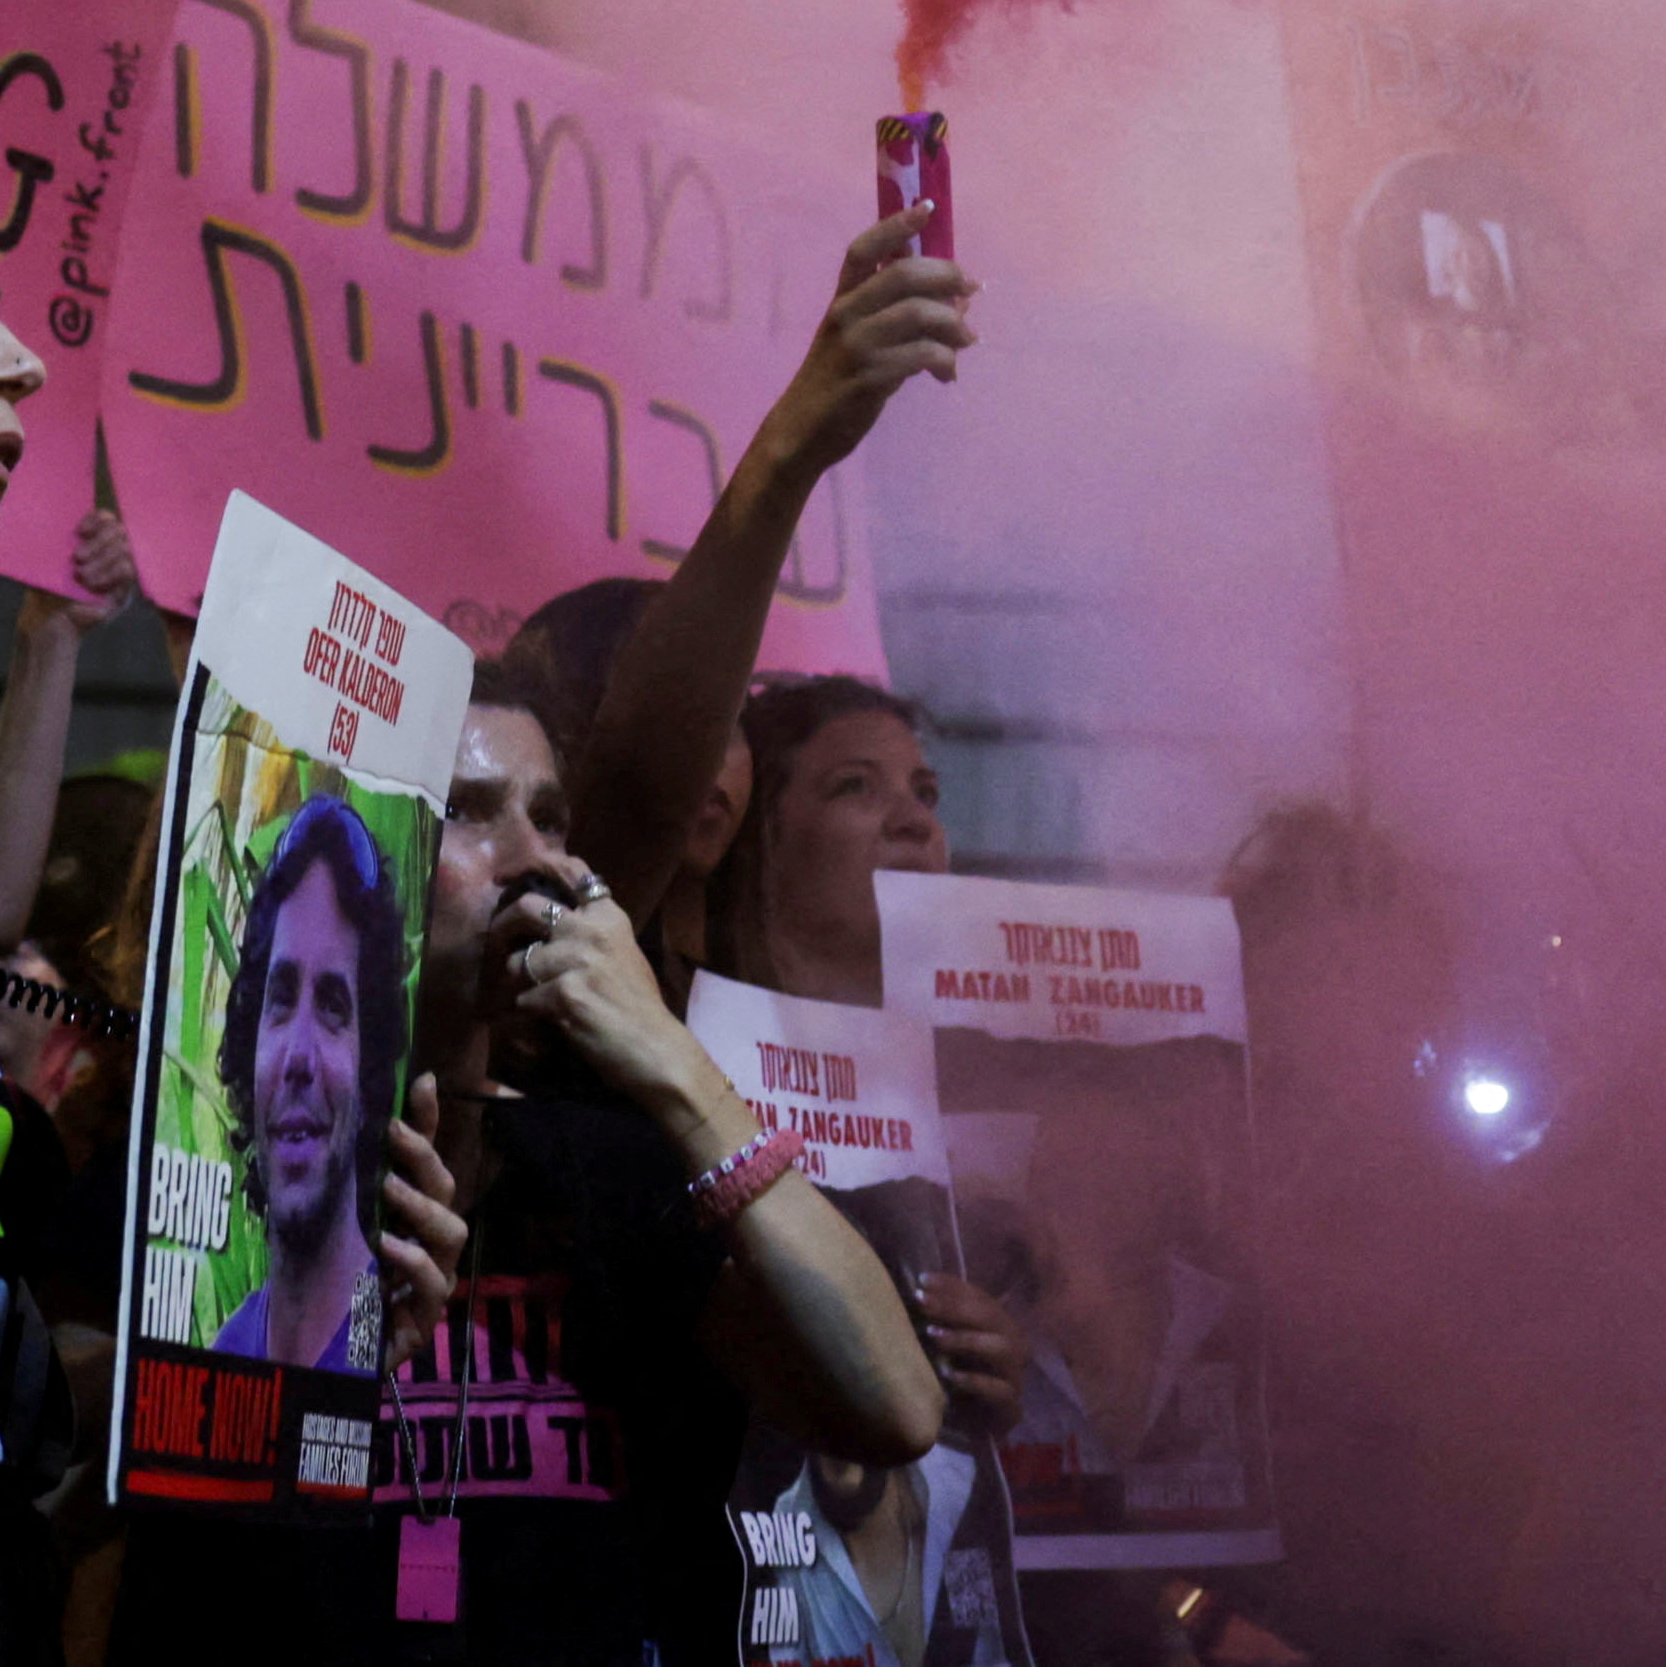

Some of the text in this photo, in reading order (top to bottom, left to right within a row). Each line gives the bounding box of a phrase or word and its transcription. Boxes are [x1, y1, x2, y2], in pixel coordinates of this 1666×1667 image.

[48, 39, 143, 348] @pink.front
[327, 579, 377, 651] קלדרון
[375, 609, 407, 667] עופר
[303, 626, 405, 727] OFER KALDERON
[326, 699, 361, 766] (53)
[1098, 926, 1141, 972] מתן
[934, 969, 1206, 1014] MATAN ZANGAUKER
[1055, 1009, 1102, 1037] (24)
[822, 1053, 857, 1103] מתן
[789, 1106, 915, 1152] ZANGAUKER
[147, 1147, 232, 1252] BRING
[138, 1246, 197, 1345] HIM
[132, 1358, 210, 1459] HOME
[210, 1368, 284, 1467] NOW!
[740, 1510, 817, 1567] BRING
[750, 1586, 800, 1645] HIM
